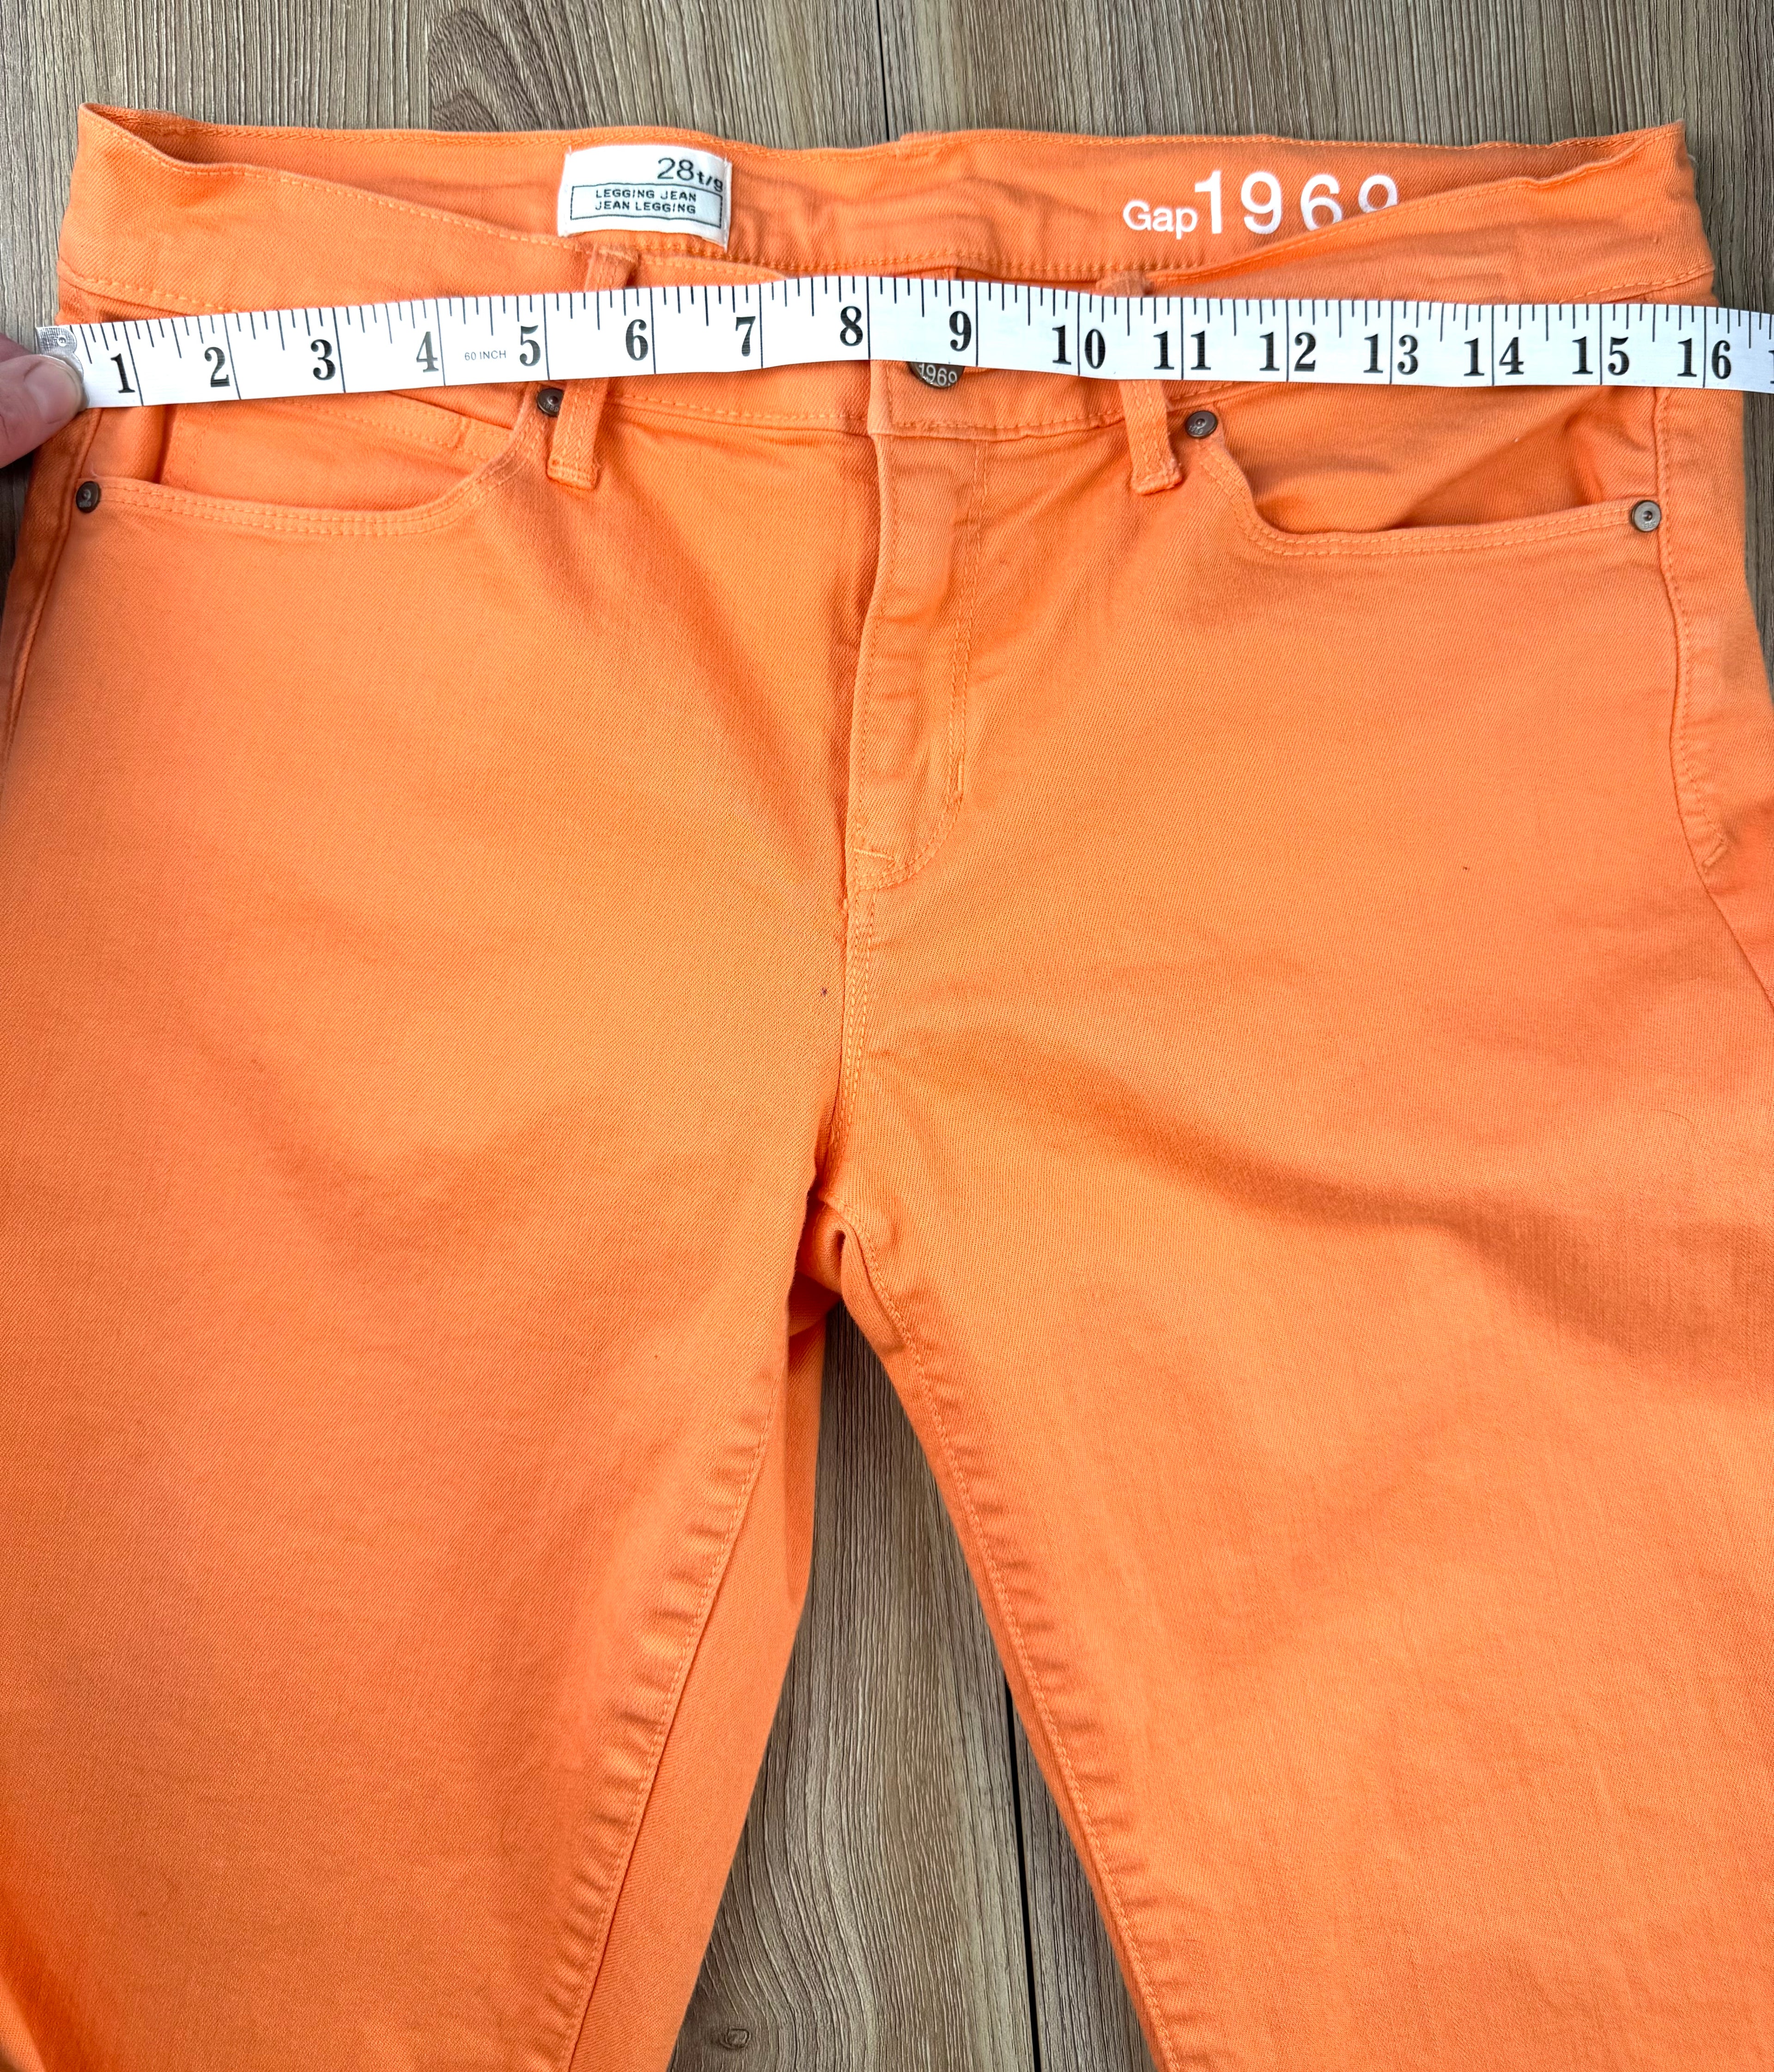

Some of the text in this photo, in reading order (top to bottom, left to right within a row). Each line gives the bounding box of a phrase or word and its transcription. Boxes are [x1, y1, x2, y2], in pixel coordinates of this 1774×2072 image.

[595, 188, 697, 202] LEGGING JEAN
[595, 200, 696, 214] JEAN LEGGING
[110, 353, 136, 394] 1
[204, 347, 230, 388] 2
[310, 339, 336, 380] 3
[416, 331, 439, 373] 4
[519, 325, 541, 366] 5
[625, 319, 649, 361] 6
[735, 316, 756, 357] 7
[839, 305, 863, 347] 8
[949, 310, 972, 352] 9
[1051, 324, 1106, 370] 10
[1153, 330, 1212, 370] 11
[1259, 331, 1317, 372] 12
[1363, 334, 1419, 375] 13
[1464, 336, 1525, 377] 14
[1572, 336, 1630, 376] 15
[1677, 337, 1732, 380] 16
[464, 350, 506, 361] 60 INCH
